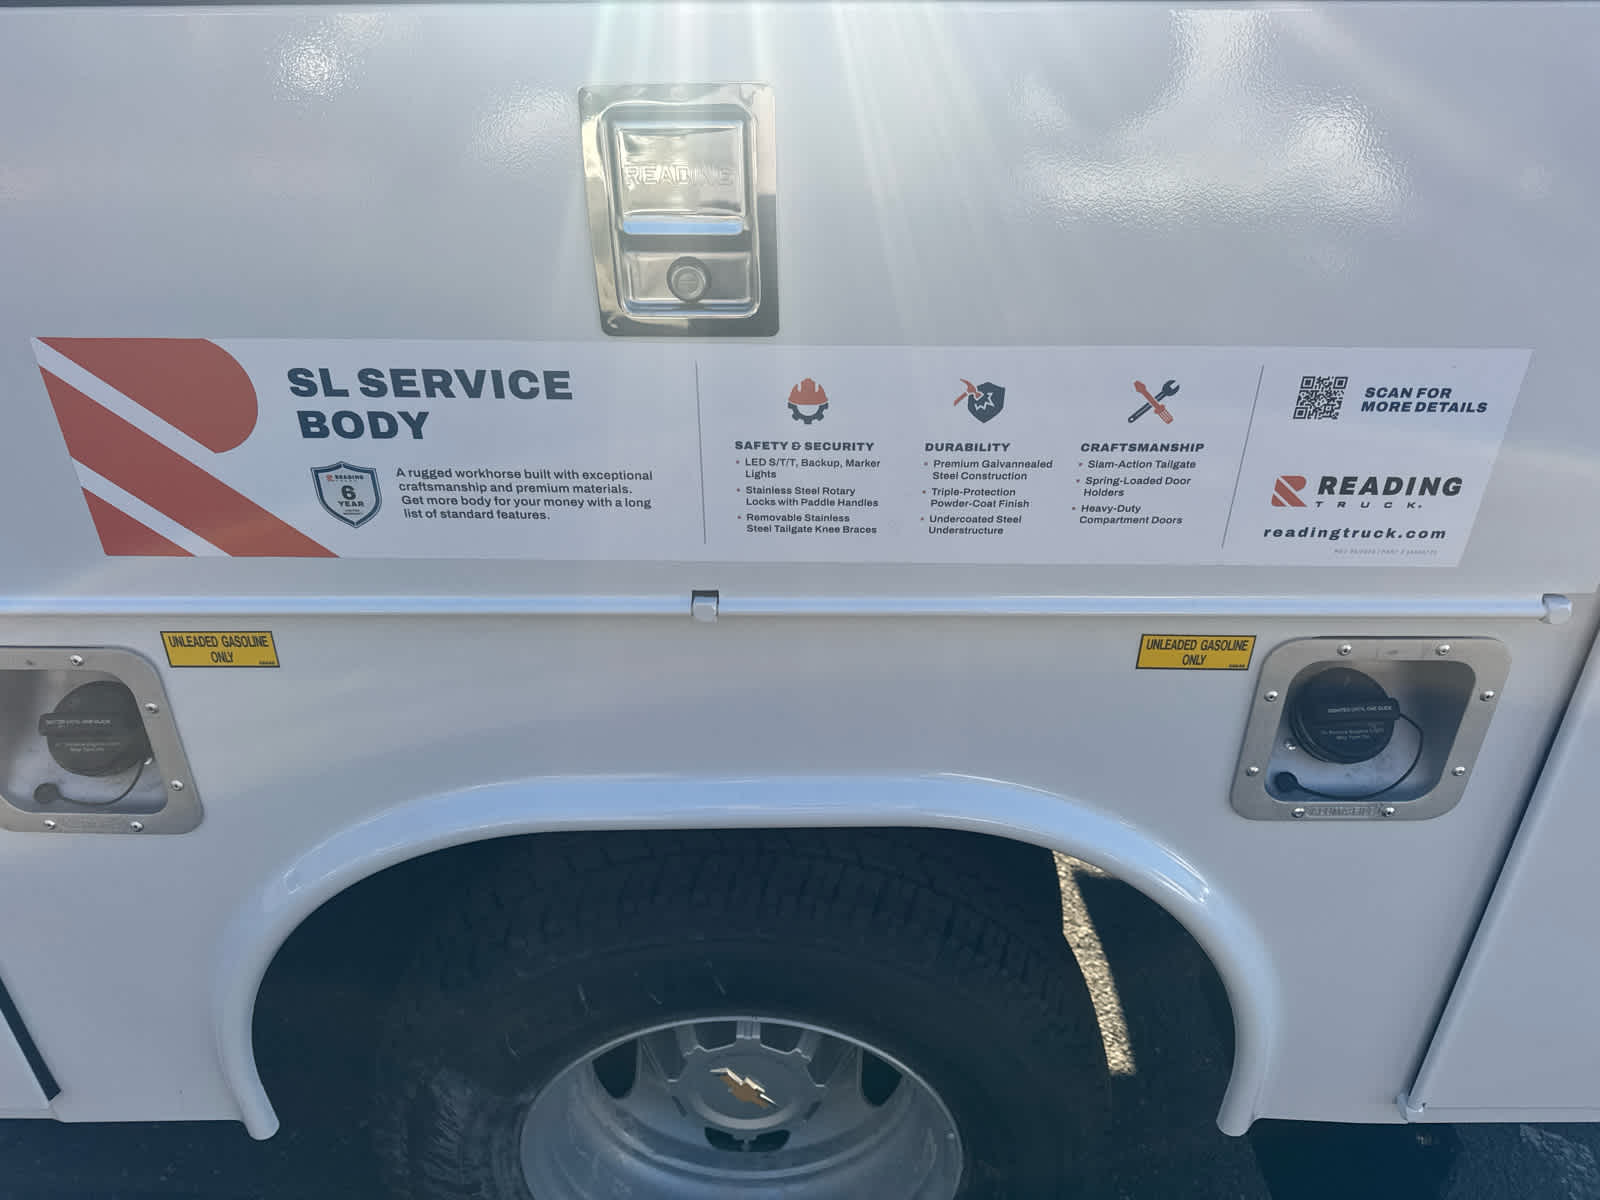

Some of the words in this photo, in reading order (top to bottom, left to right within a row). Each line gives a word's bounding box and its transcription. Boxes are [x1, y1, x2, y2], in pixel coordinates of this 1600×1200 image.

[287, 367, 349, 397] SL
[357, 368, 573, 400] SERVICE
[1365, 387, 1413, 398] SCAN
[1416, 388, 1452, 399] FOR
[1361, 401, 1413, 412] MORE
[1415, 402, 1488, 413] DETAILS
[297, 410, 429, 439] BODY
[735, 441, 789, 450] SAFETY
[804, 442, 875, 451] SECURITY
[925, 443, 1010, 452] DURABILITY
[1080, 443, 1205, 452] CRAFTSMANSHIP
[745, 458, 767, 466] LED
[801, 459, 843, 468] Backup,
[845, 459, 881, 467] Marker
[934, 460, 980, 468] Premium
[981, 460, 1053, 468] Galvannealed
[1088, 460, 1152, 468] Slam-Action
[1155, 460, 1196, 470] Tailgate
[396, 467, 406, 477] A
[408, 468, 452, 480] rugged
[455, 468, 522, 479] workhorse
[524, 469, 551, 479] built
[554, 470, 579, 480] with
[582, 470, 653, 481] exceptional
[745, 470, 777, 479] Lights
[933, 472, 959, 480] Steel
[960, 472, 1028, 480] Construction
[1085, 476, 1162, 486] Spring-Loaded
[1165, 477, 1191, 485] Door
[1318, 476, 1463, 496] READING
[341, 485, 356, 500] 6
[399, 482, 487, 494] craftsmanship
[490, 483, 513, 492] and
[516, 484, 569, 494] premium
[572, 484, 632, 494] materials.
[746, 486, 792, 495] Stainless
[794, 487, 820, 495] Steel
[822, 487, 856, 496] Rotary
[932, 488, 1016, 497] Triple-Protection
[1083, 488, 1125, 496] Holders
[401, 495, 423, 505] Get
[427, 497, 458, 505] more
[460, 496, 491, 507] body
[494, 496, 511, 506] for
[513, 498, 541, 508] your
[543, 498, 584, 508] money
[587, 497, 612, 507] with
[615, 499, 622, 507] a
[624, 498, 652, 509] long
[746, 498, 776, 506] Locks
[778, 498, 799, 506] with
[801, 498, 836, 507] Paddle
[837, 499, 879, 507] Handles
[930, 500, 996, 508] Powder-Coat
[998, 500, 1030, 508] Finish
[1081, 504, 1141, 514] Heavy-Duty
[404, 509, 423, 518] list
[425, 509, 437, 518] of
[440, 509, 494, 519] standard
[497, 509, 550, 520] features.
[747, 513, 802, 522] Removable
[804, 514, 850, 522] Stainless
[929, 515, 994, 523] Undercoated
[996, 515, 1022, 523] Steel
[1079, 516, 1149, 525] Compartment
[1151, 516, 1183, 524] Doors
[747, 525, 772, 533] Steel
[774, 525, 813, 534] Tailgate
[815, 525, 841, 533] Knee
[843, 525, 877, 534] Braces
[928, 526, 1004, 534] Understructure
[1263, 527, 1446, 541] readingtruck.com
[167, 635, 218, 648] UNLEADED
[221, 635, 269, 648] GASOLINE
[1146, 639, 1197, 650] UNLEADED
[1200, 639, 1248, 651] GASOLINE
[210, 651, 233, 663] ONLY
[1182, 654, 1207, 666] ONLY
